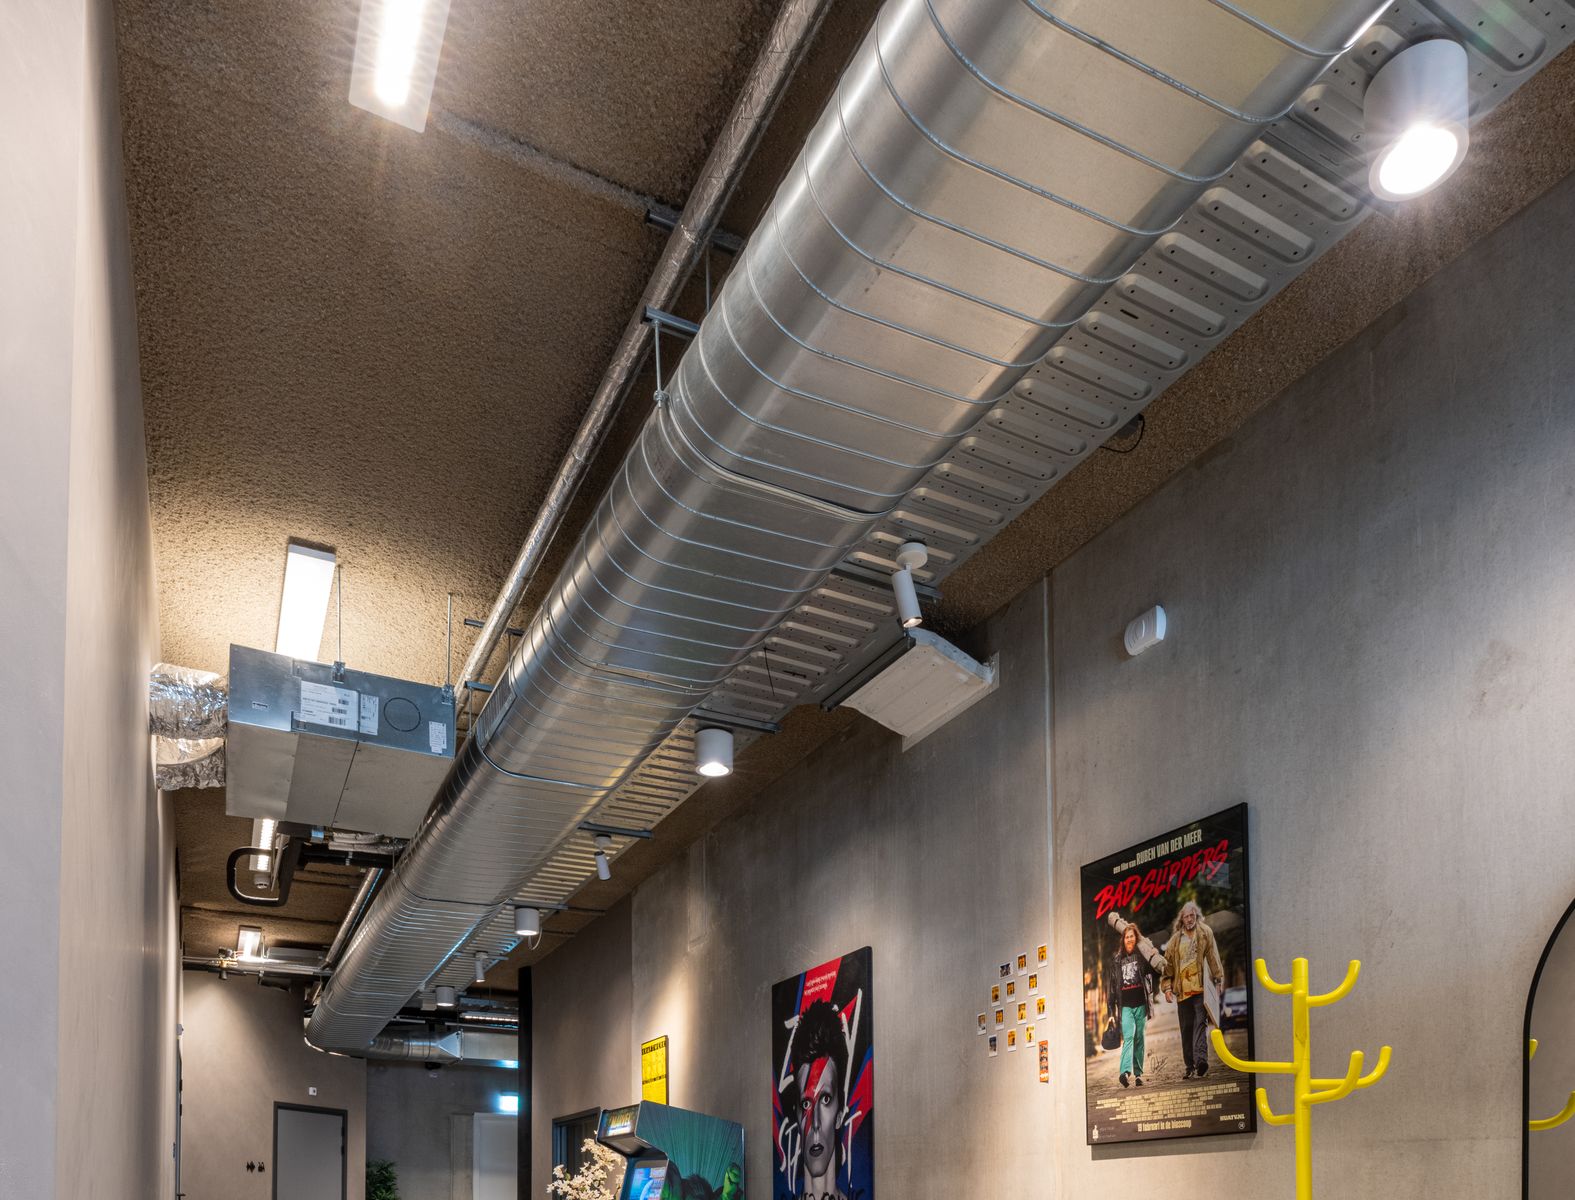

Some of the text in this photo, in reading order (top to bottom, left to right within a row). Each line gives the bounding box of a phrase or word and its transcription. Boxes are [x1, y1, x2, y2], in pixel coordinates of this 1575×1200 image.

[1136, 846, 1156, 866] RUBEN
[1156, 840, 1170, 858] VAN
[1170, 835, 1183, 853] DER
[1183, 828, 1203, 848] MEER
[1093, 839, 1229, 920] BAD SLIPPERS
